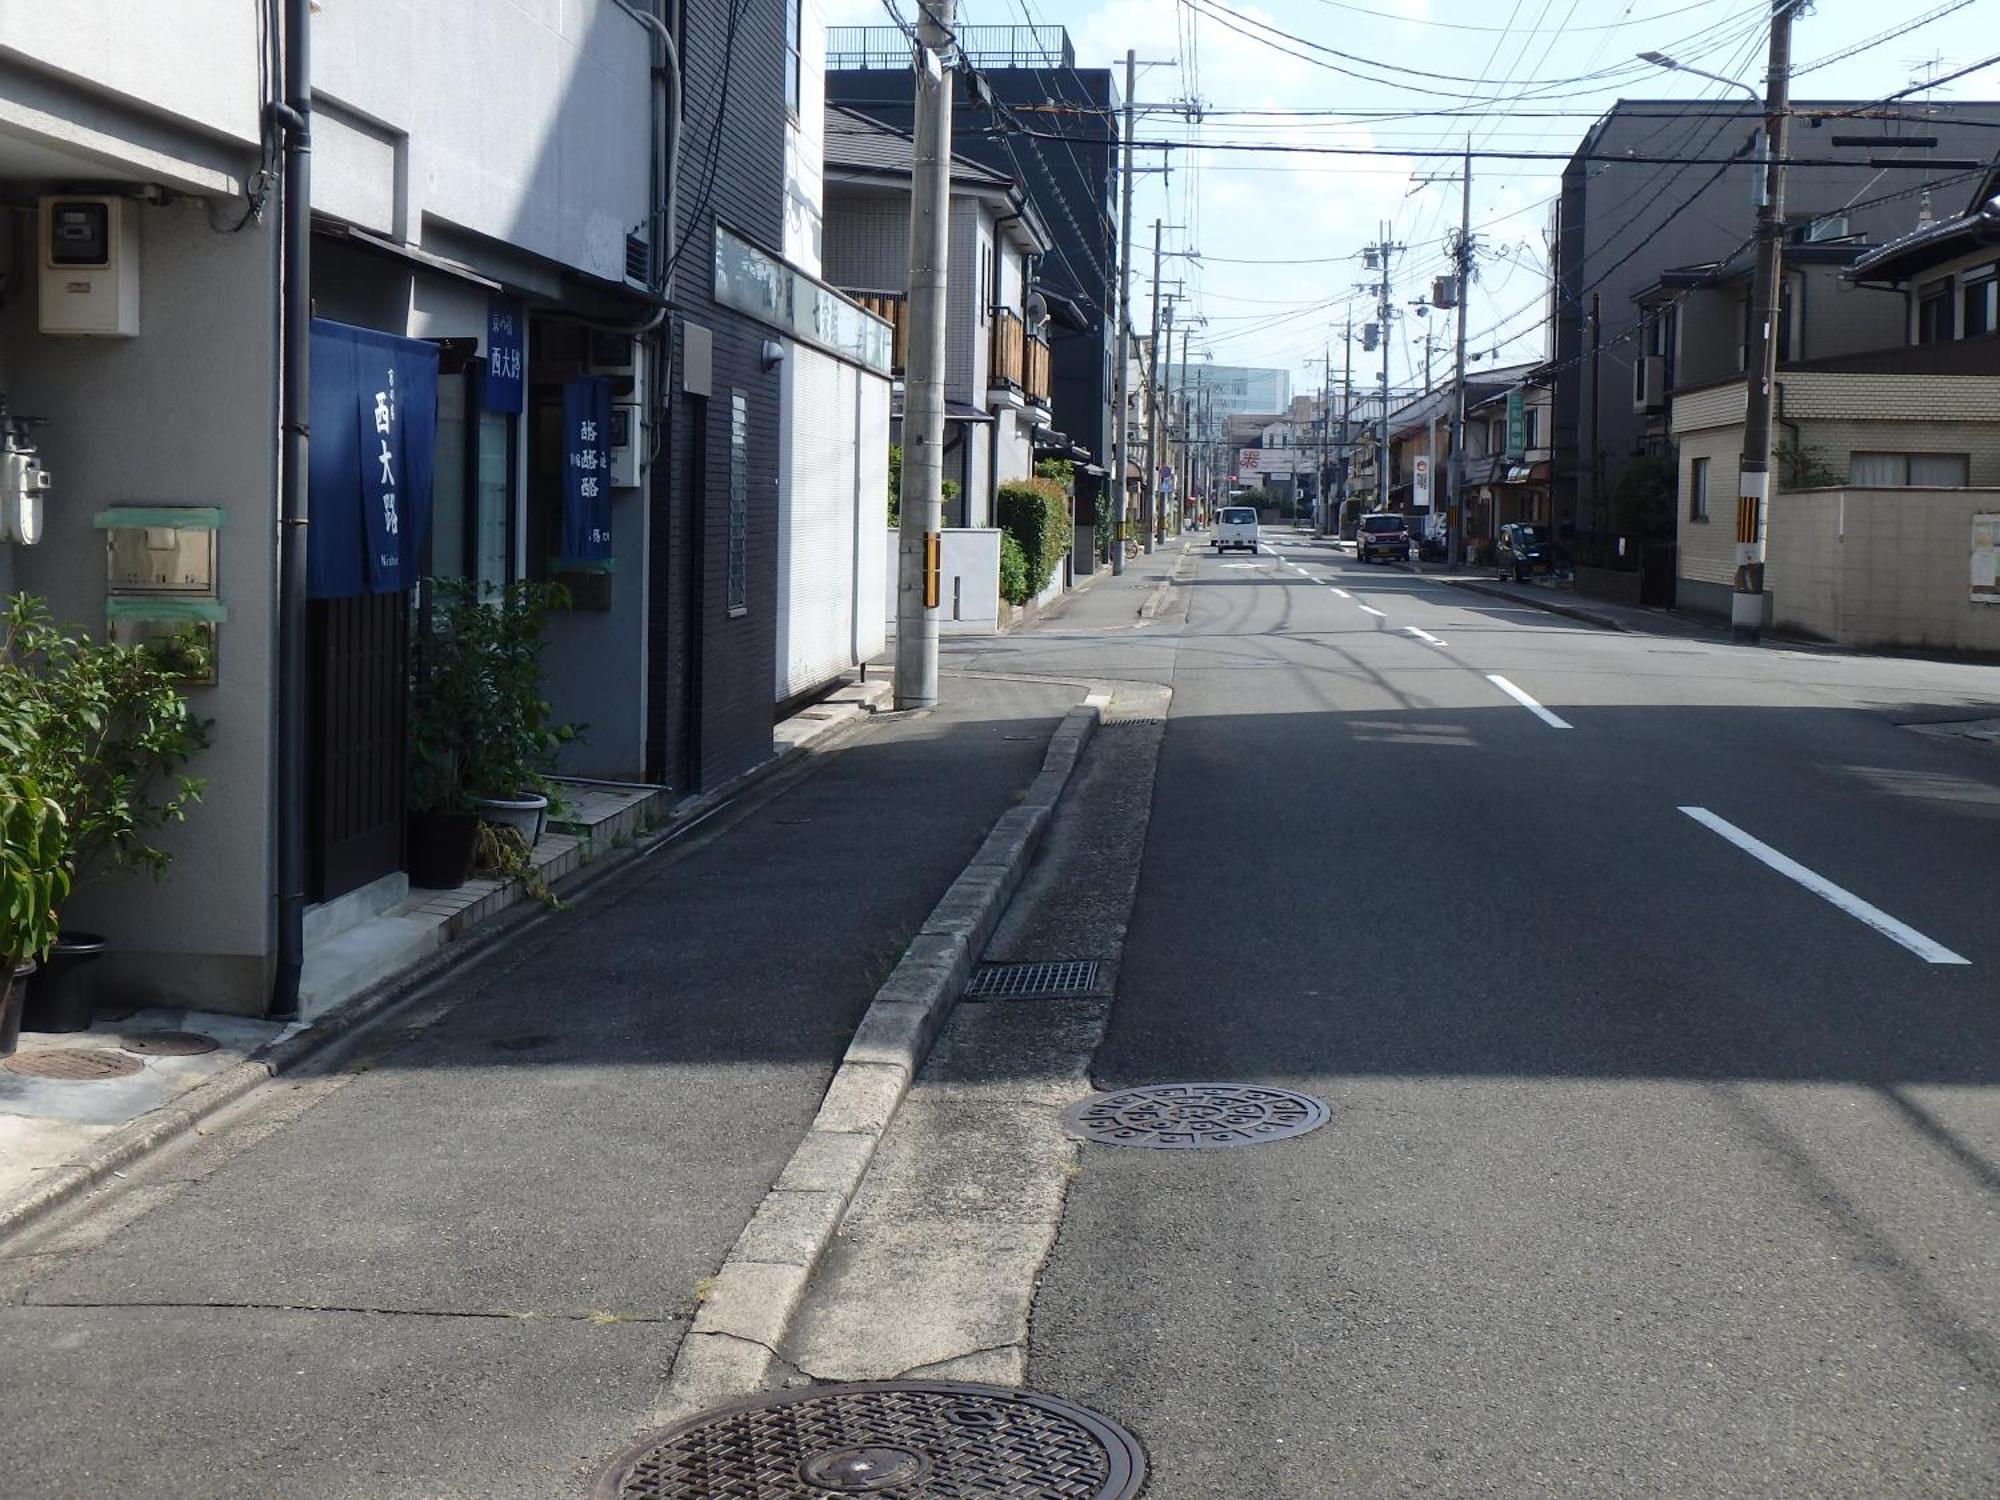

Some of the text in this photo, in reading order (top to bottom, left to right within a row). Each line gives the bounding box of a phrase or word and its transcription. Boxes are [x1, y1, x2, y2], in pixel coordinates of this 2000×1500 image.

[491, 346, 521, 381] 西大路
[374, 391, 399, 536] 西大路
